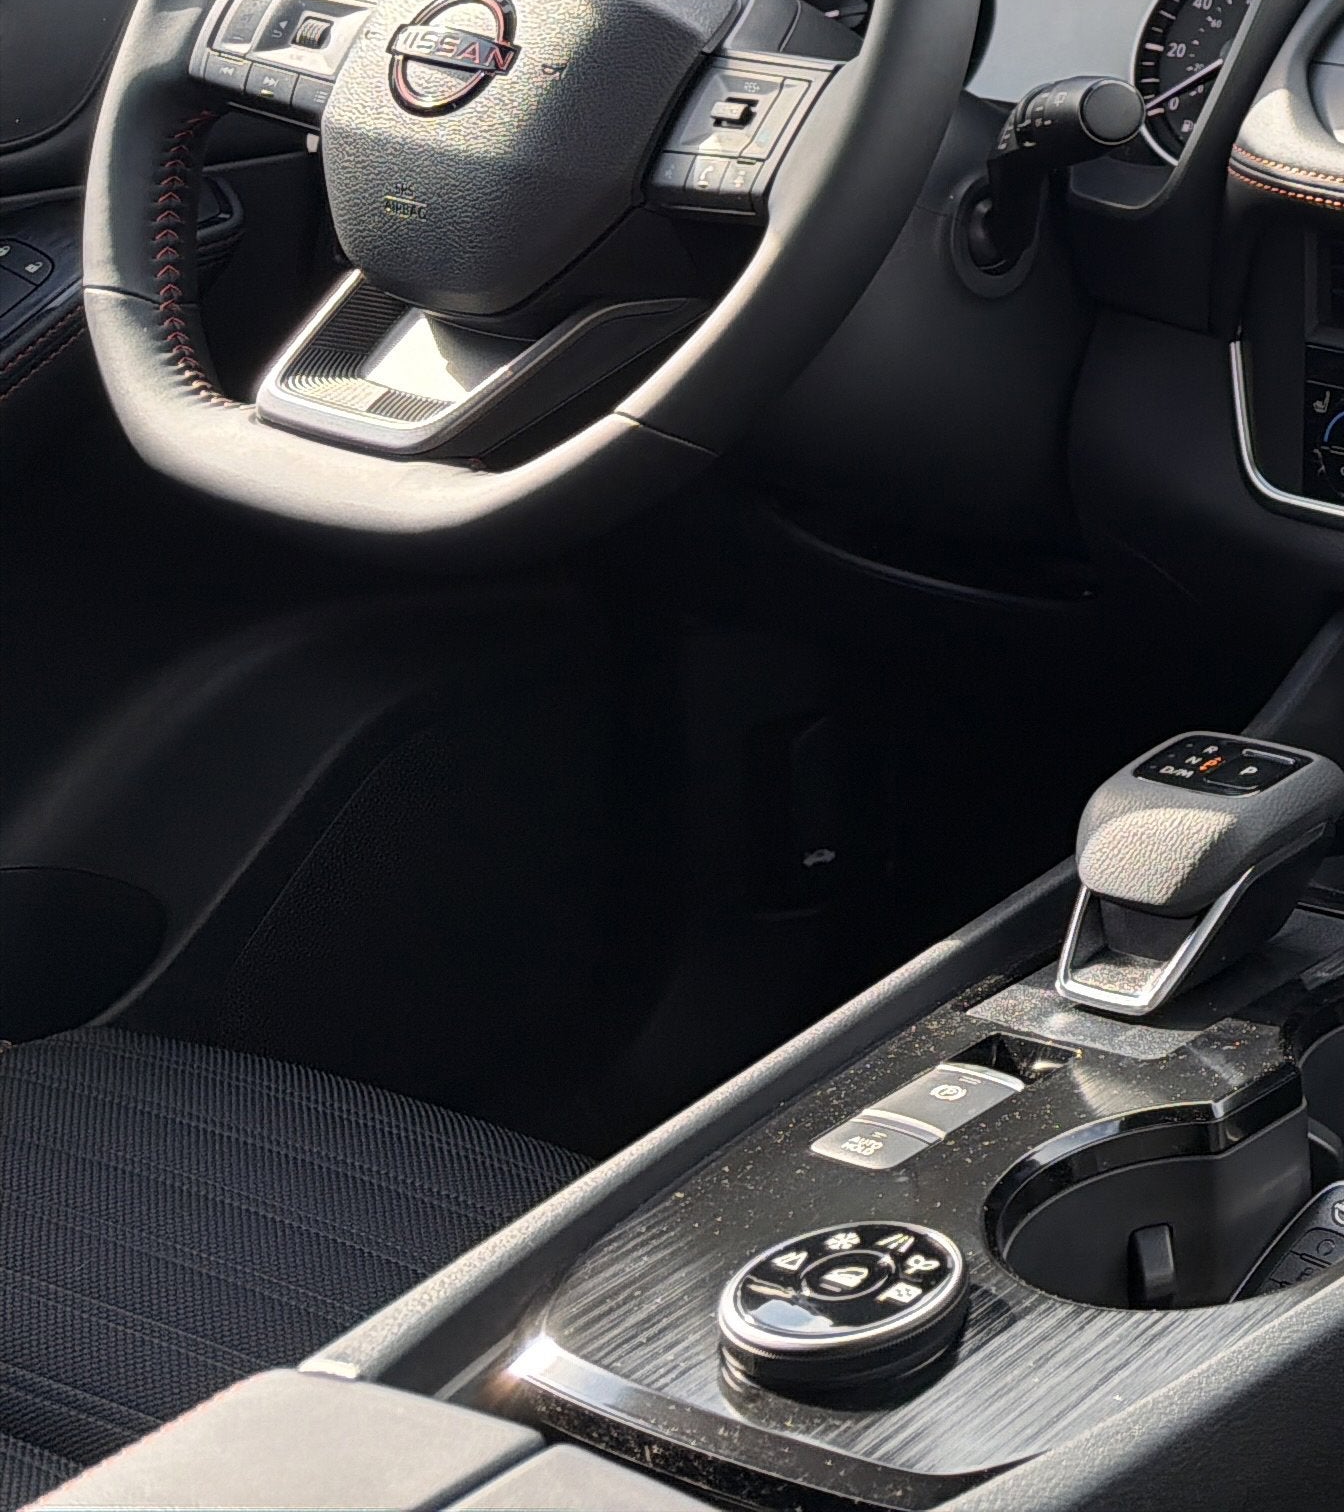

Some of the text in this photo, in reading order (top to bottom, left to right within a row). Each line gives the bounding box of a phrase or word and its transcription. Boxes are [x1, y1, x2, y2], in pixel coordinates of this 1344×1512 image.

[1166, 42, 1187, 59] 20
[1168, 96, 1180, 112] 0
[1184, 755, 1203, 765] N
[1238, 766, 1259, 776] P
